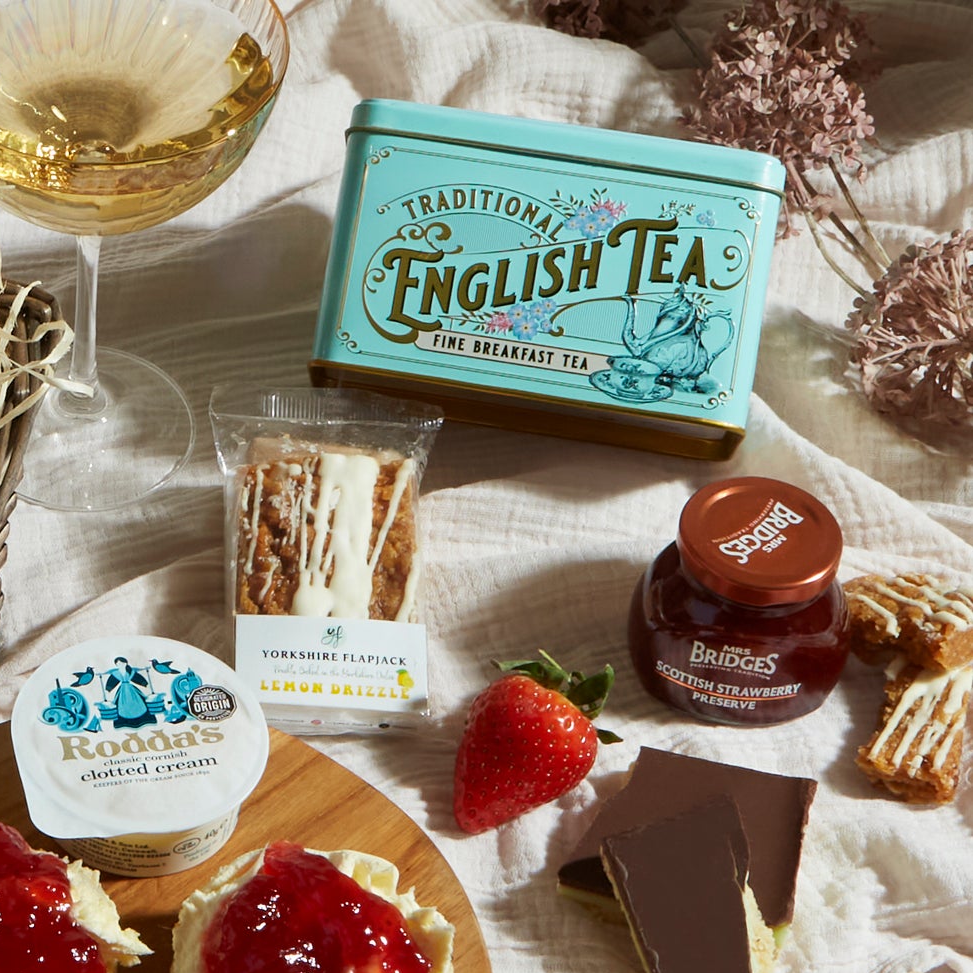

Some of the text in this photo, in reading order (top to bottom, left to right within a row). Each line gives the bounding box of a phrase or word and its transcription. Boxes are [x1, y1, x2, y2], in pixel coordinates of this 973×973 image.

[402, 188, 567, 242] TRADITIONAL
[381, 216, 709, 332] ENGLISH TEA
[432, 334, 590, 371] FINE BREAKFAST TEA
[719, 502, 803, 564] BRIDGES
[762, 534, 787, 553] MRS
[262, 650, 407, 665] YORKSHIRE FLAPJACK
[690, 641, 779, 674] BRIDGES
[723, 645, 751, 655] MRS
[260, 680, 410, 699] LEMON DRIZZLE
[656, 661, 801, 697] SCOTTISH STRAWBERRY
[194, 699, 230, 712] ORIGIN
[693, 692, 756, 710] PRESERVE
[58, 725, 225, 761] Rodda's
[81, 757, 218, 782] clotted cream
[104, 751, 187, 766] classic cornish
